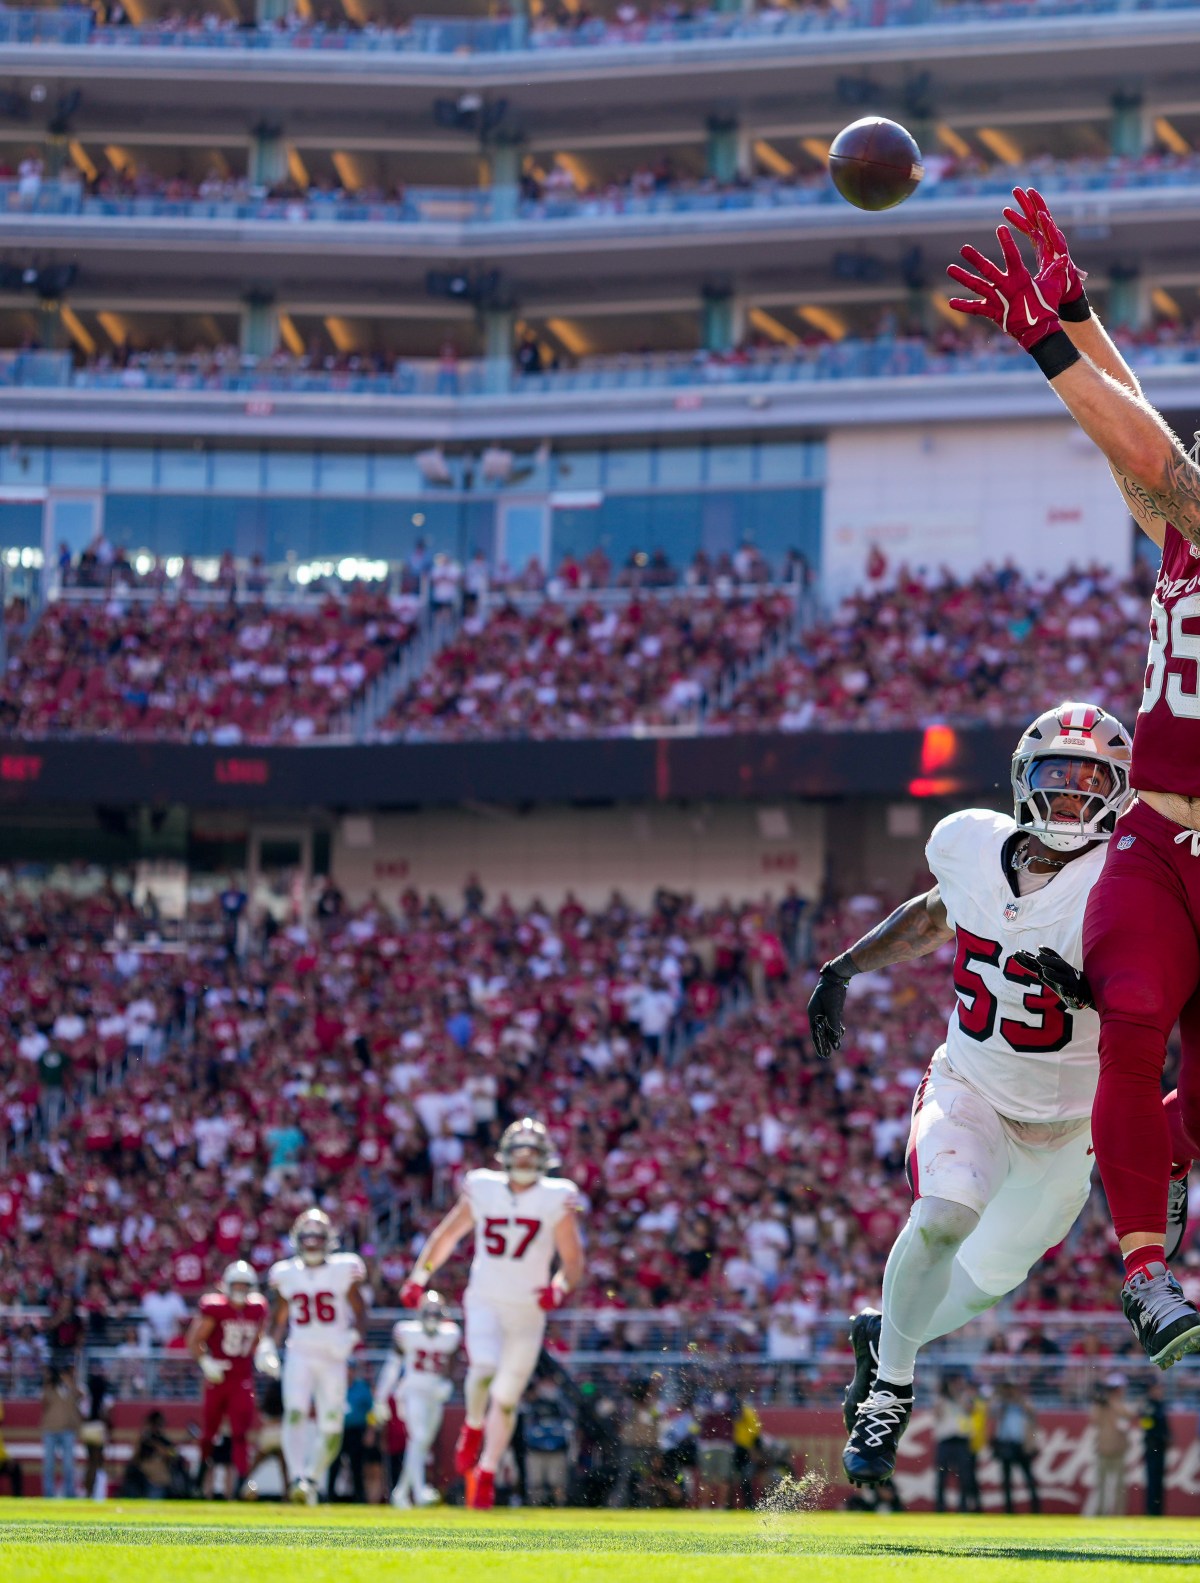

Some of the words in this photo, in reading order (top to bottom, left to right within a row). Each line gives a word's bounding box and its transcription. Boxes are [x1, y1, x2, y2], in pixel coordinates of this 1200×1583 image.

[953, 921, 1073, 1053] 53
[484, 1217, 541, 1259] 57
[293, 1292, 335, 1324] 36
